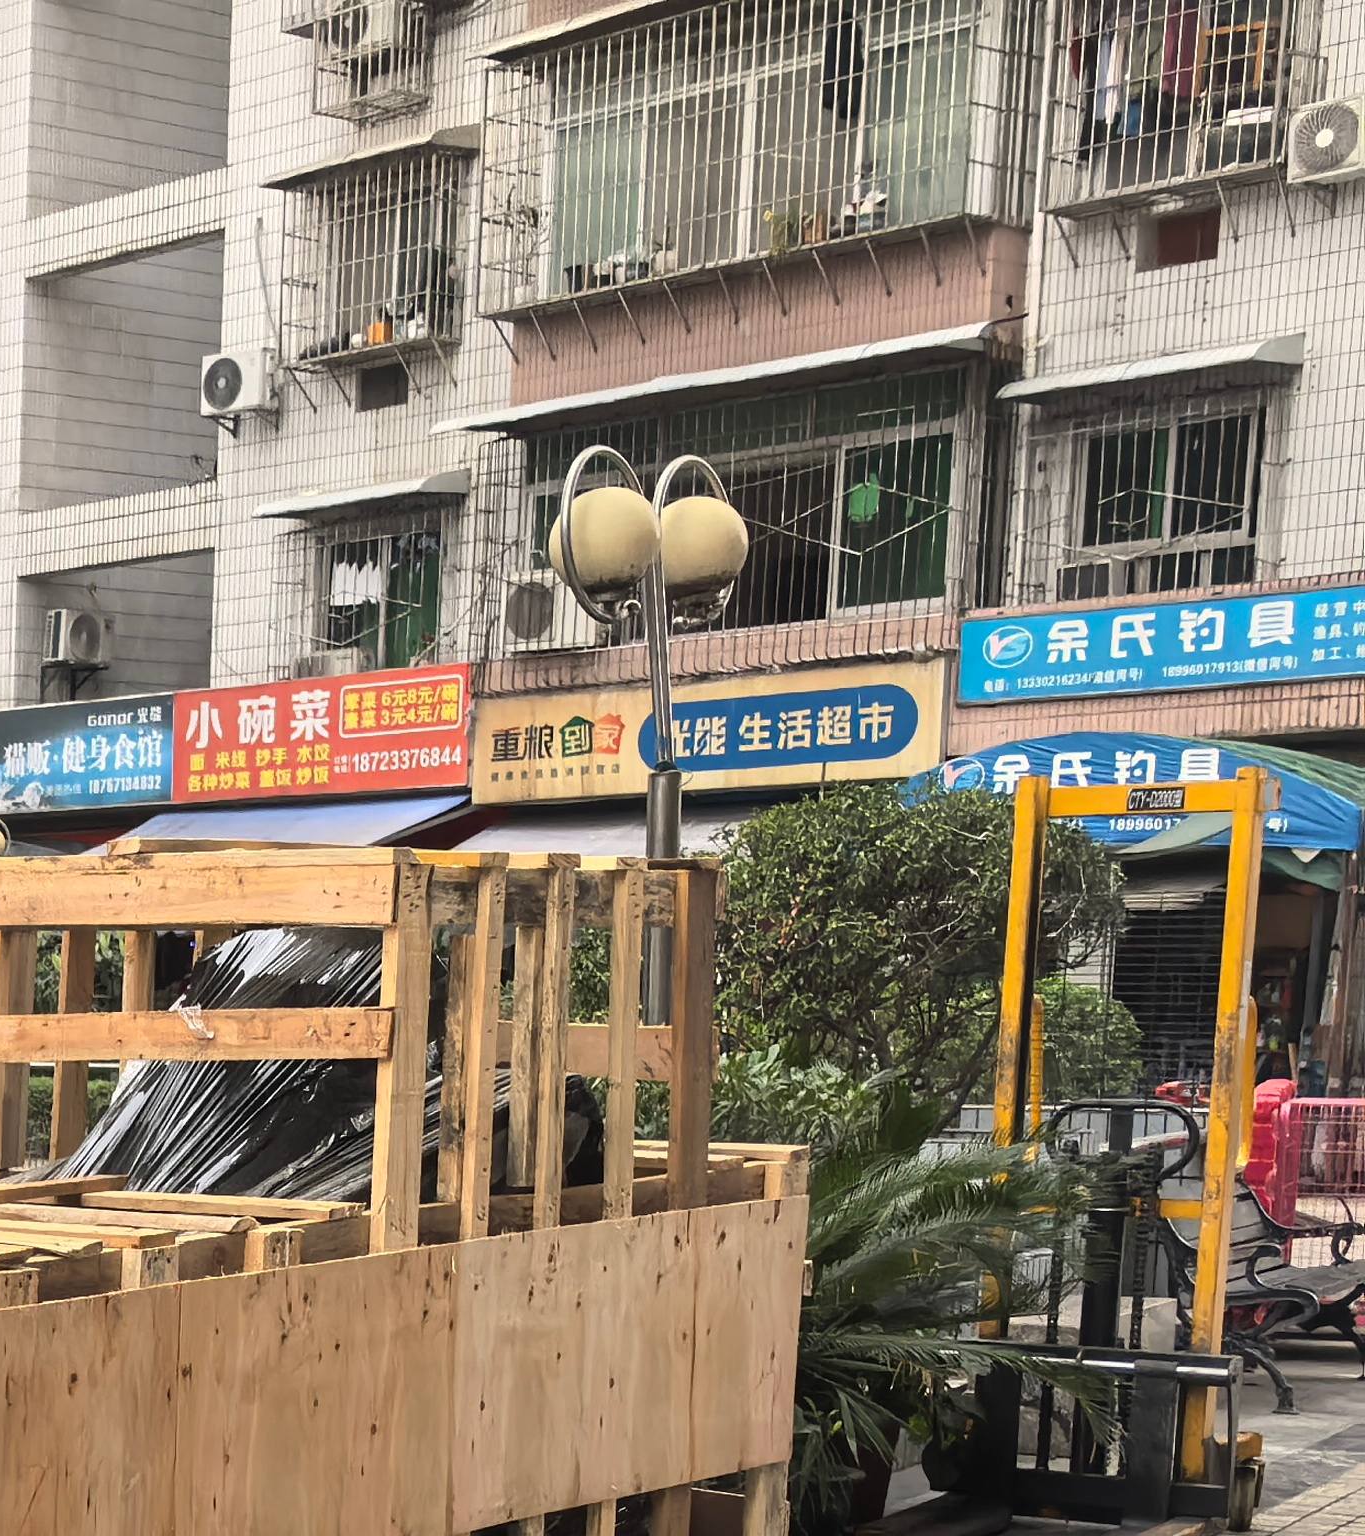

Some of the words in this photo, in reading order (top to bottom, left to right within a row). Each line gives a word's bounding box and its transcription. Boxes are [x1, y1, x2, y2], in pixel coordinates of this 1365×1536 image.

[1046, 601, 1295, 664] 余氏钓具
[381, 684, 459, 706] 6元8元/碗
[186, 689, 331, 749] 小碗菜
[380, 702, 459, 726] 3元4元/碗
[738, 702, 895, 752] 生活超市
[491, 713, 626, 762] 重粮到家
[190, 753, 205, 771] 面
[215, 750, 247, 769] 米线
[297, 743, 330, 764] 水饺
[352, 744, 462, 773] 18723376844
[992, 748, 1220, 794] 余氏钓具
[188, 771, 251, 792] 各种炒菜
